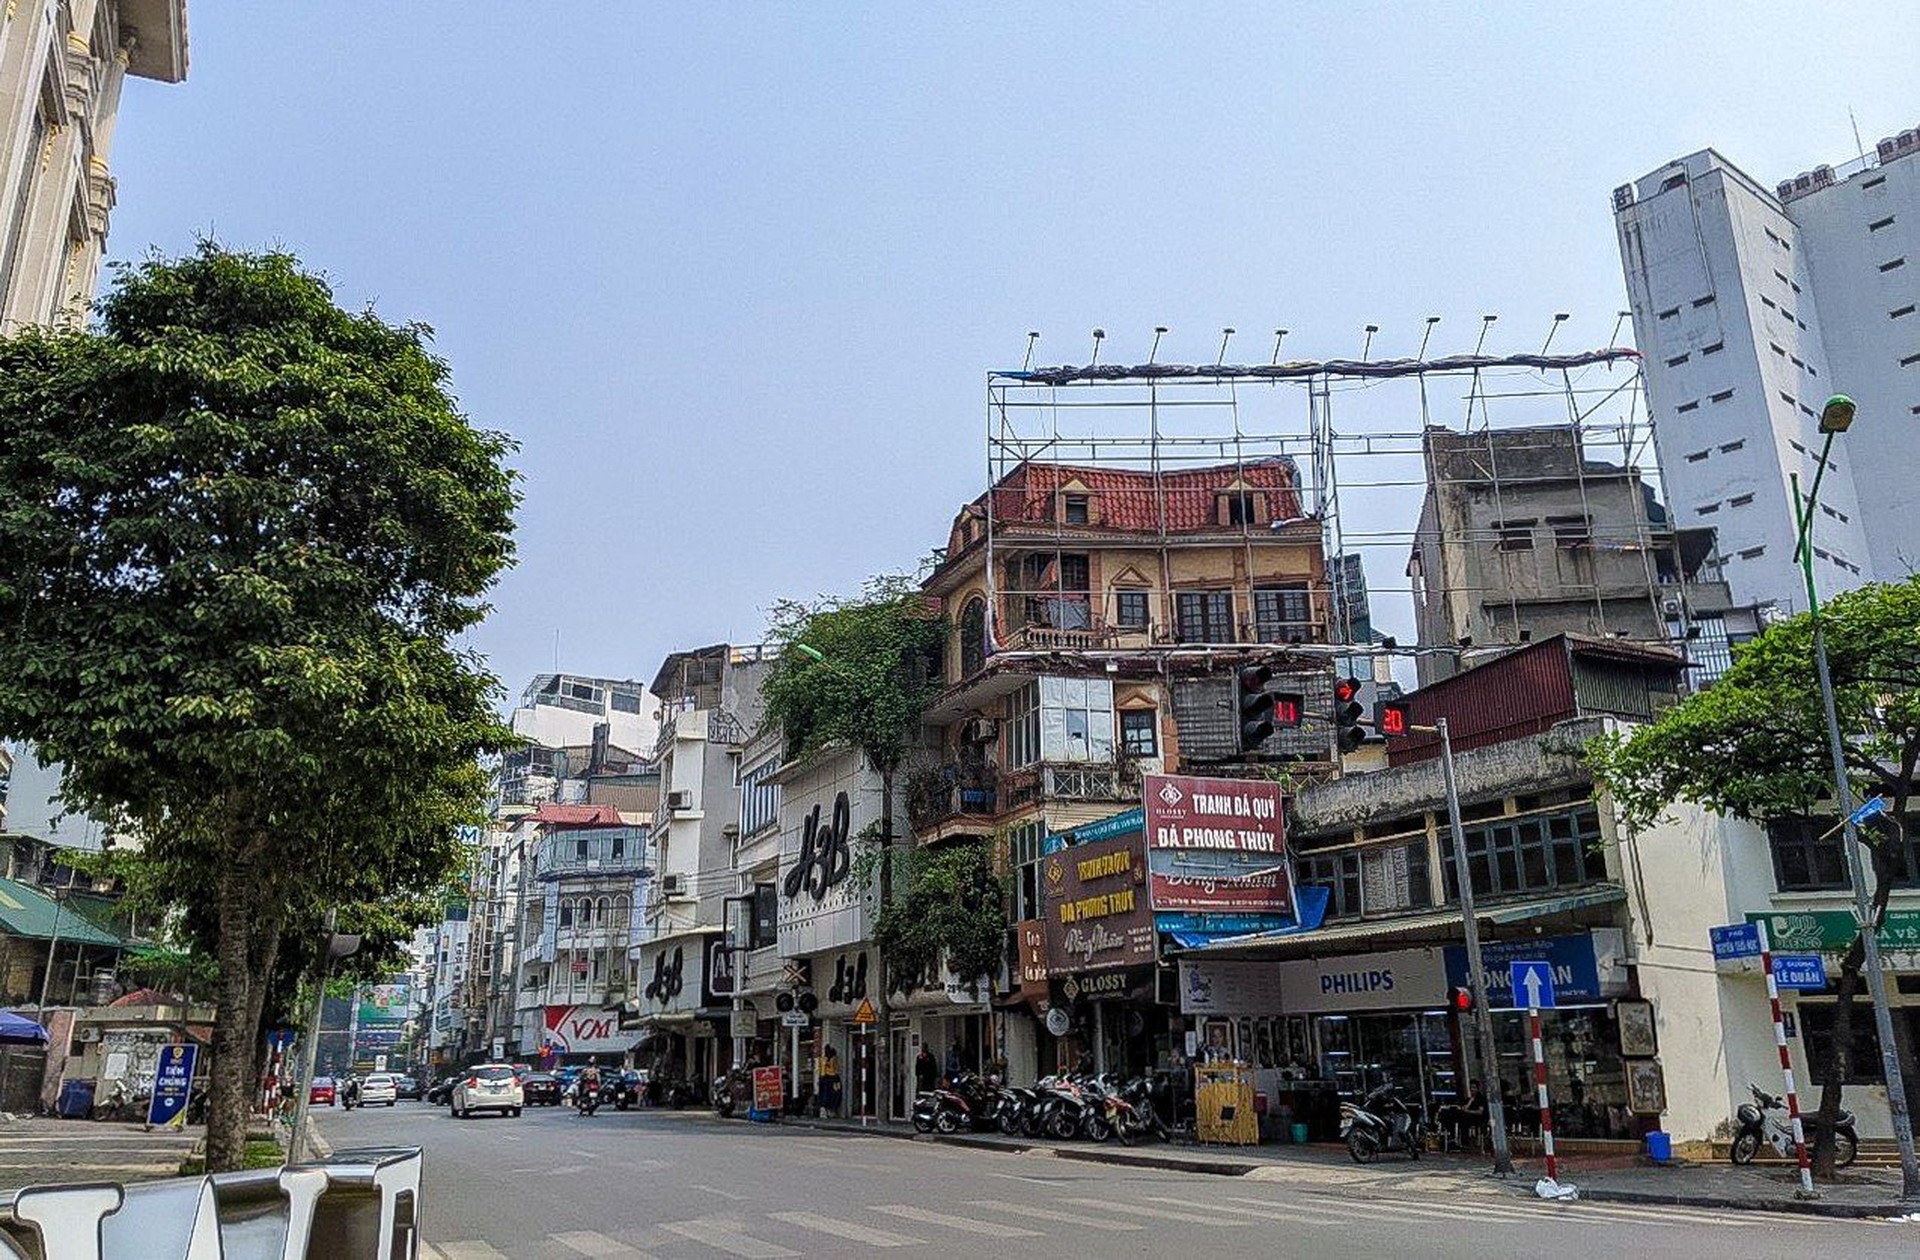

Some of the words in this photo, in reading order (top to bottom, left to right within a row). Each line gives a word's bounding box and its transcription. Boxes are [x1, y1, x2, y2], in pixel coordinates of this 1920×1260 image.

[1192, 794, 1232, 815] TRANH
[1234, 793, 1250, 816] ĐÁ
[1253, 794, 1275, 819] QUÝ
[1158, 824, 1179, 847] ĐÁ
[1183, 828, 1235, 848] PHONG
[1238, 824, 1275, 850] THỦY
[1081, 974, 1127, 993] GLOSSY
[1321, 970, 1394, 994] PHILIPS
